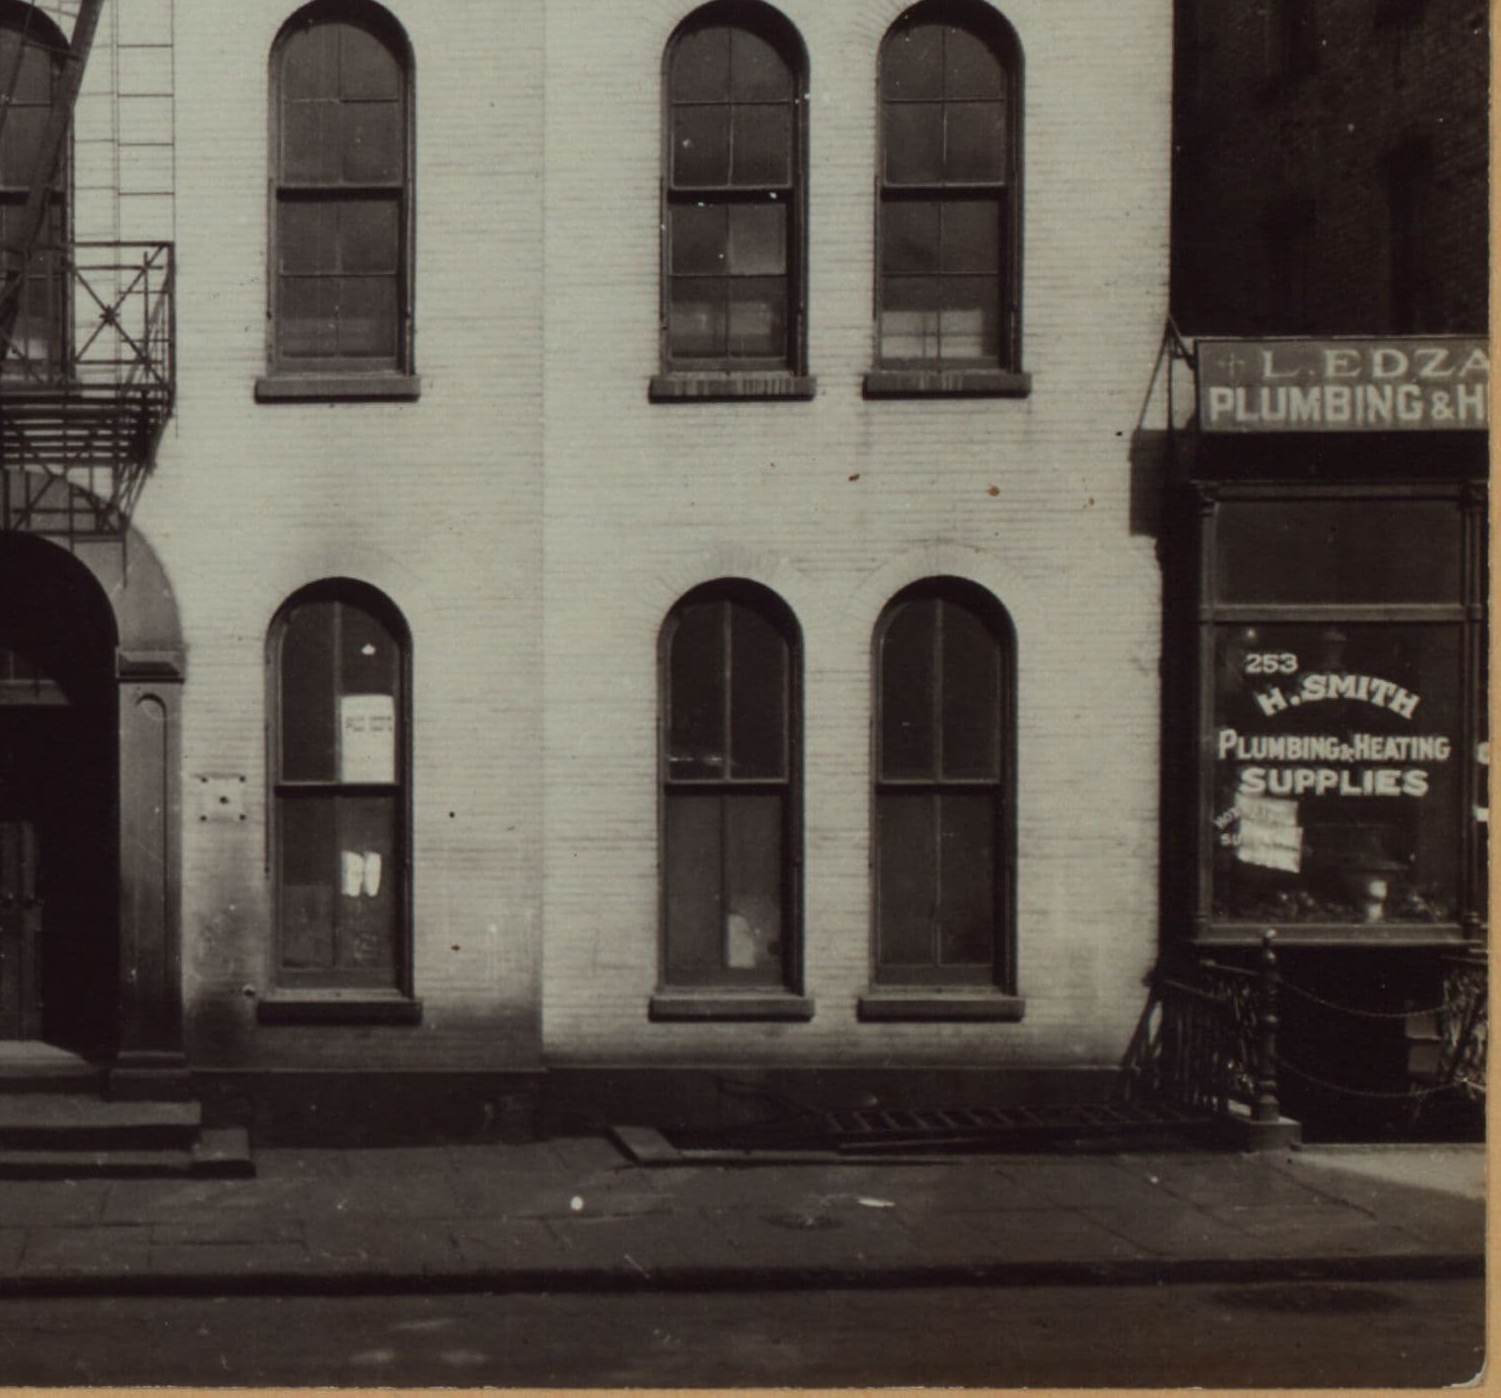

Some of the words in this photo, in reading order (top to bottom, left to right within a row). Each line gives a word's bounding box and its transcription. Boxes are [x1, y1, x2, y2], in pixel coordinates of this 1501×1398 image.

[1209, 383, 1423, 422] PLUMBING
[1430, 390, 1455, 419] &
[1457, 383, 1490, 421] H
[1245, 652, 1298, 674] 253
[1301, 673, 1421, 720] SMITH
[1239, 766, 1430, 797] SUPPLIES
